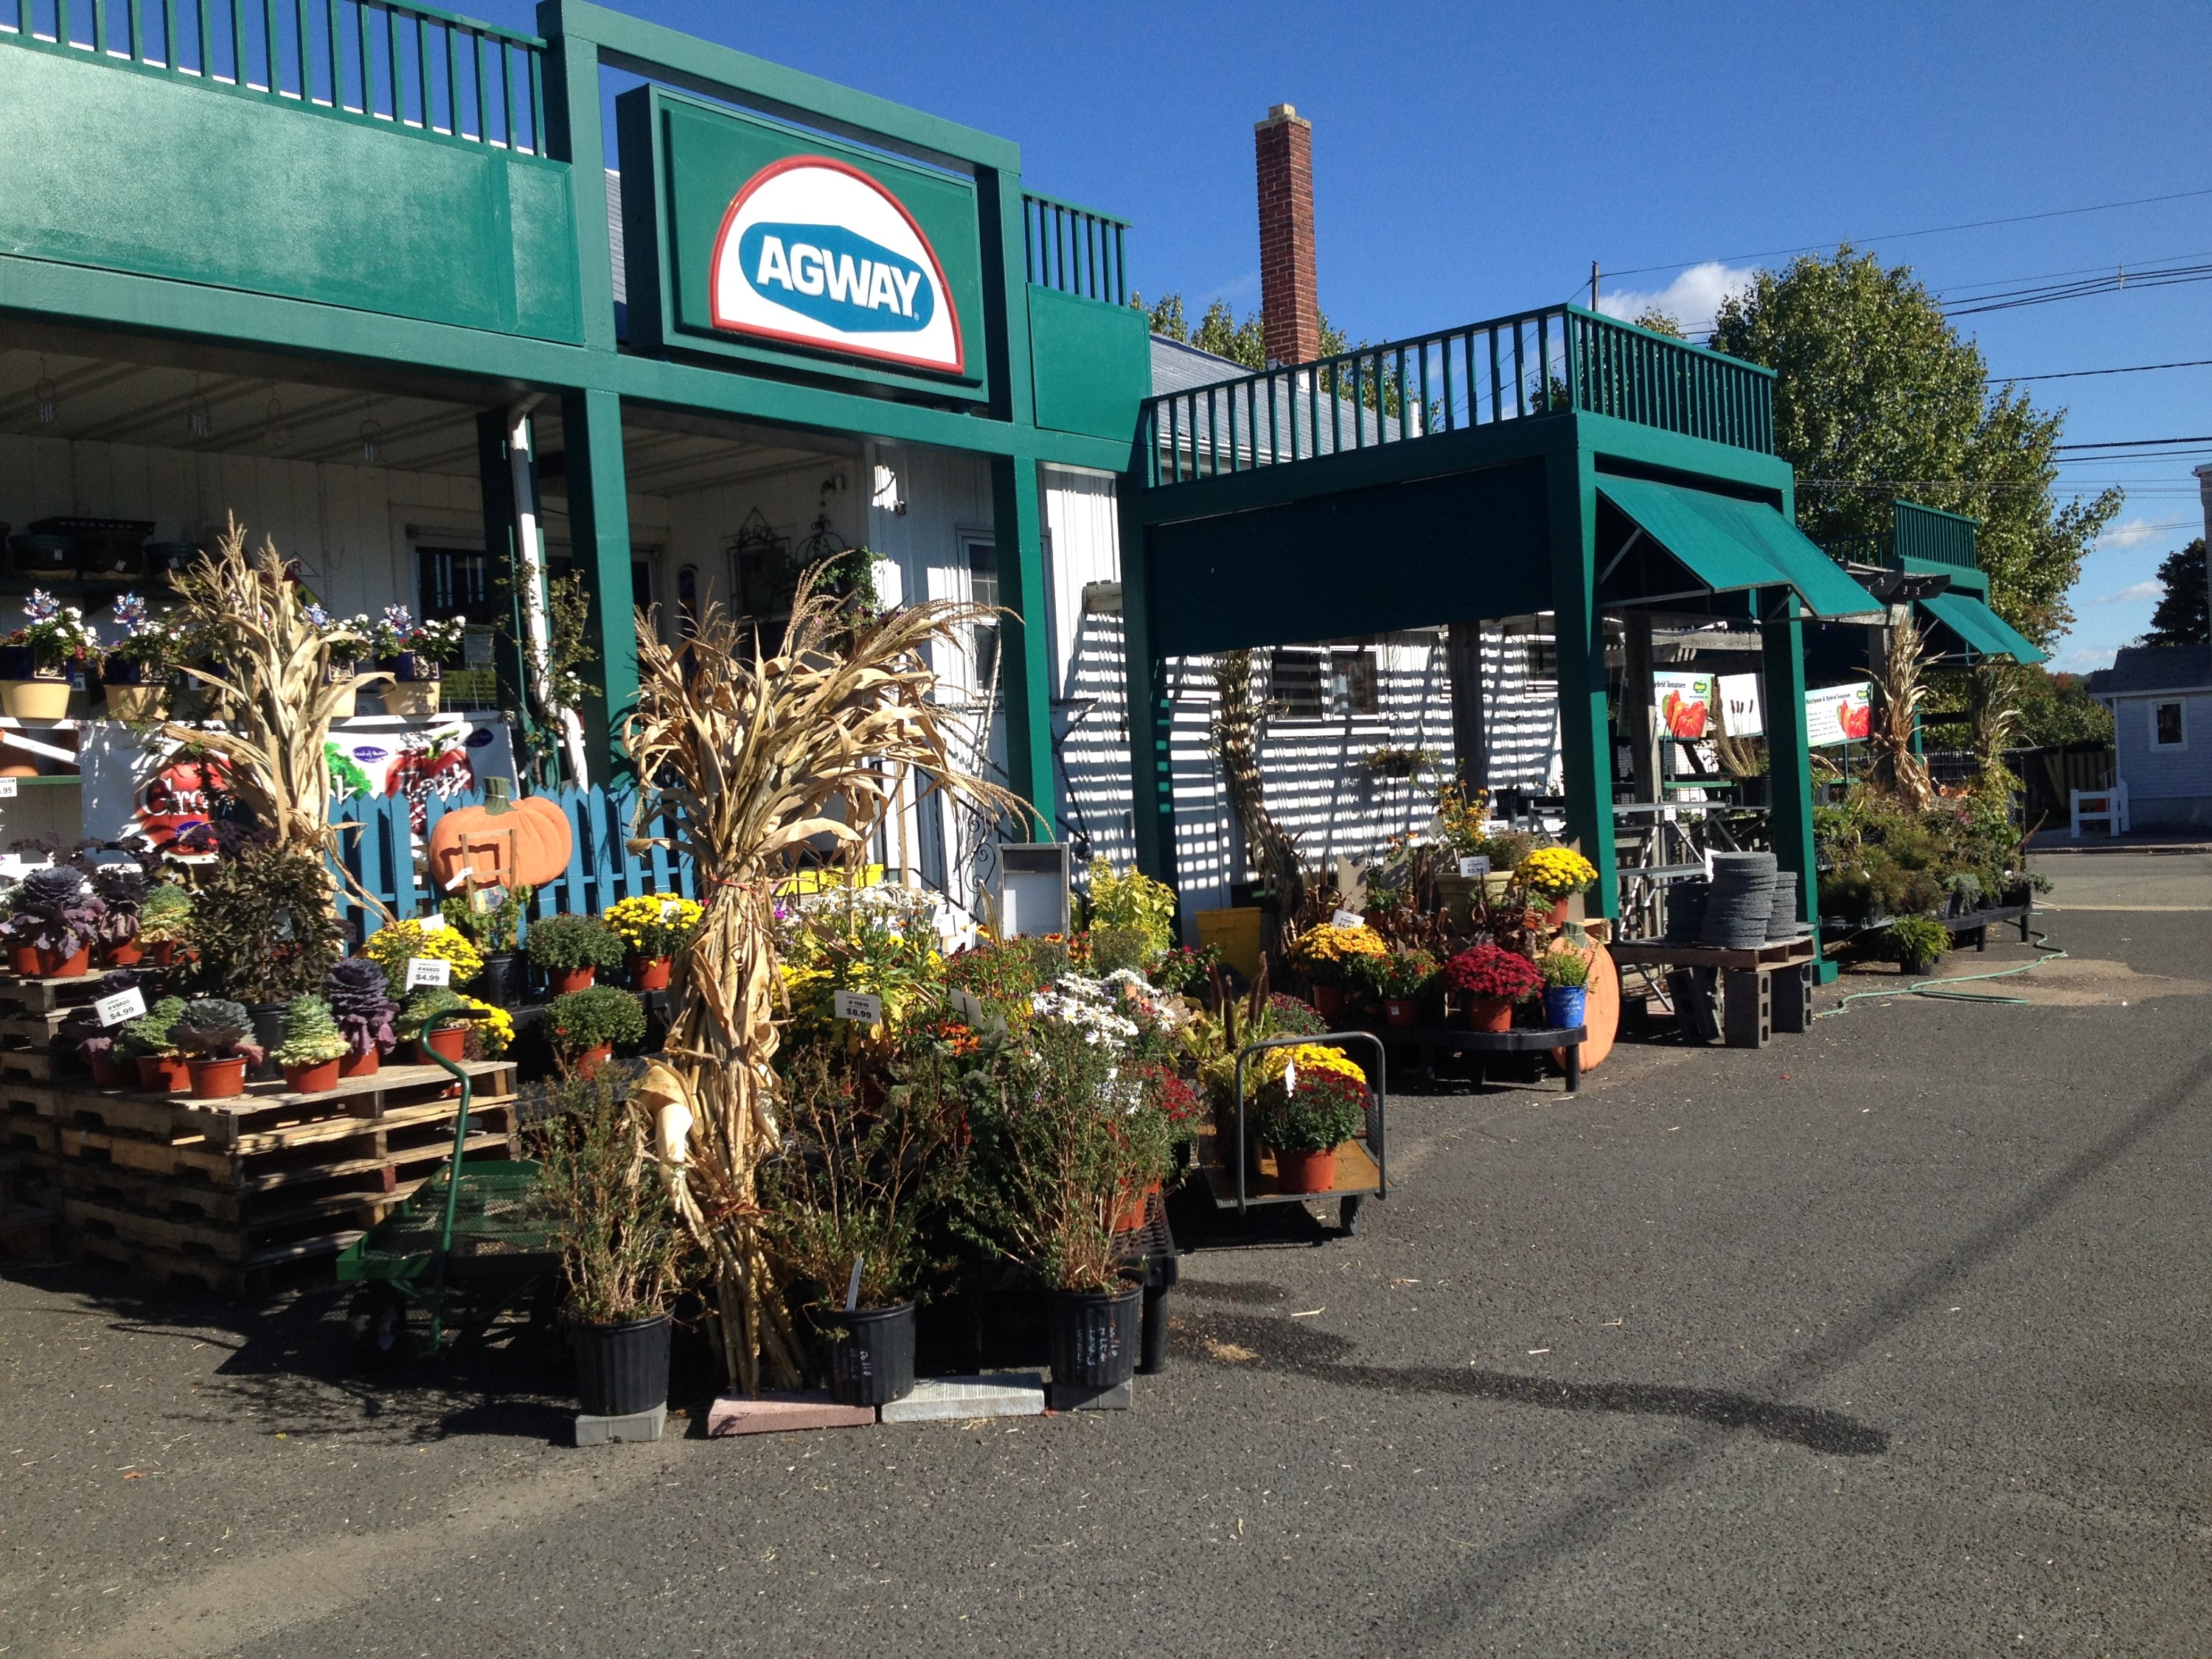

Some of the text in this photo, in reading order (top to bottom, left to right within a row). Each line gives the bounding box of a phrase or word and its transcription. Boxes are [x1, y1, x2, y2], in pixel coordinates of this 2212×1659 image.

[757, 235, 921, 317] AGWAY
[0, 786, 13, 795] .99
[416, 973, 440, 982] $4.99
[110, 1006, 134, 1020] $4.99
[846, 1007, 872, 1019] $8.99
